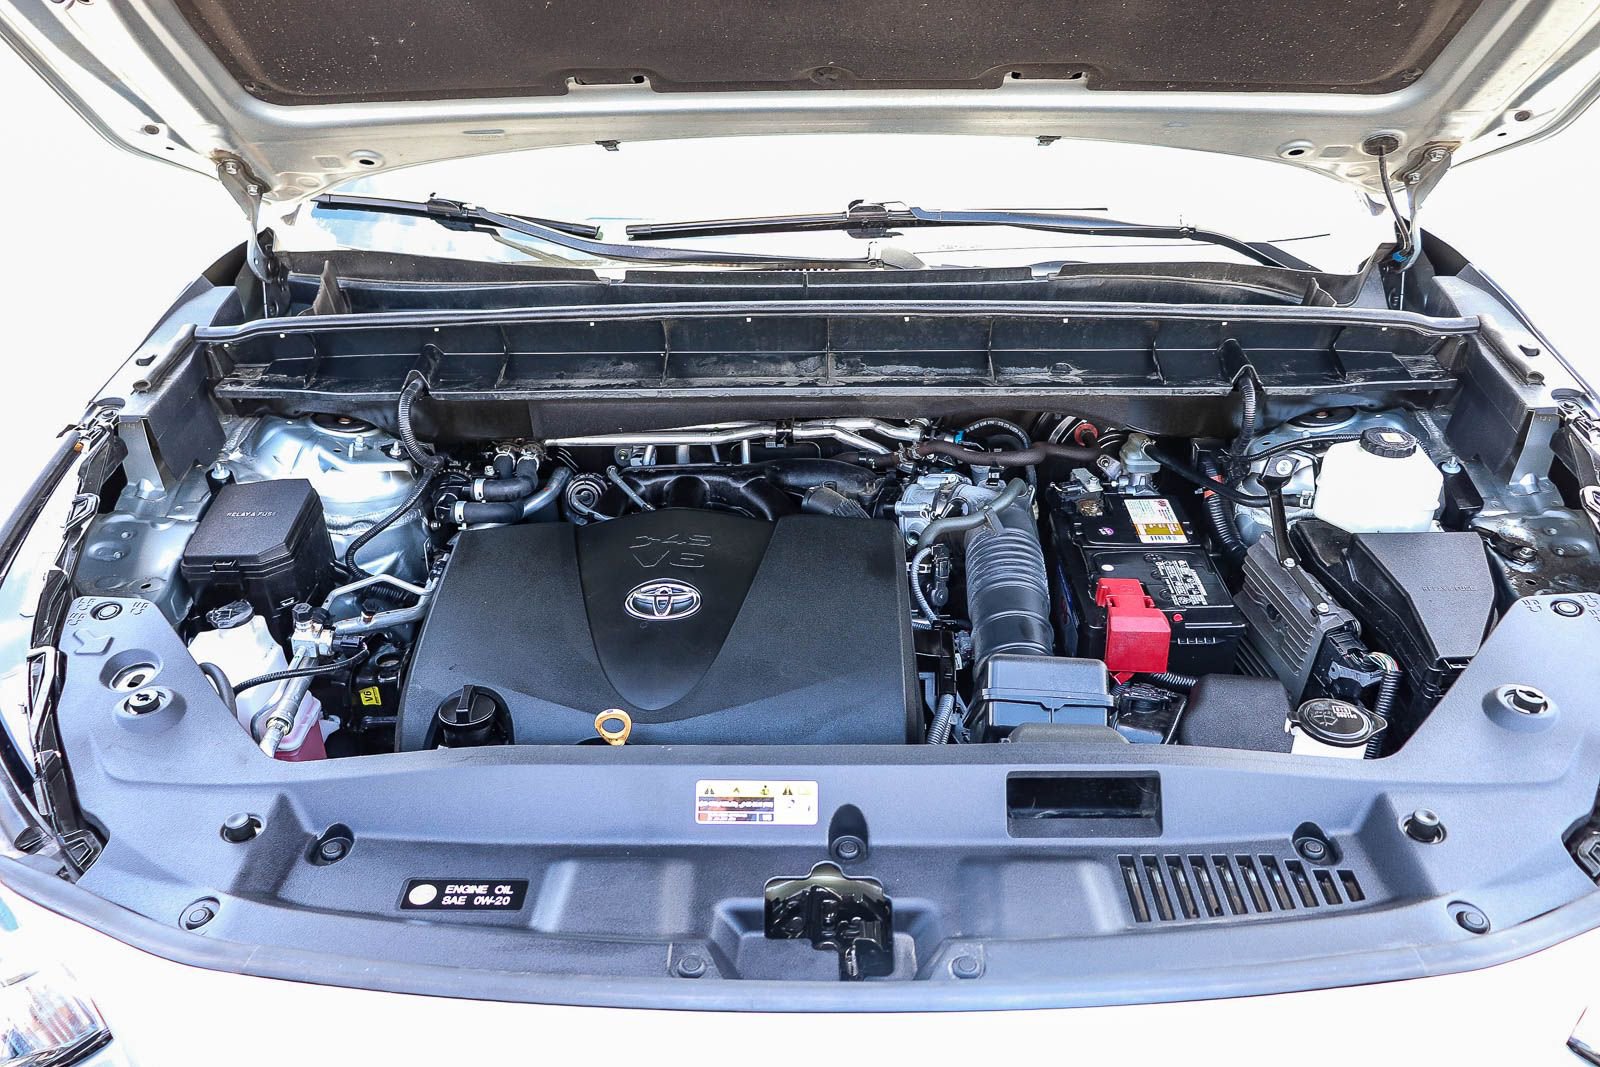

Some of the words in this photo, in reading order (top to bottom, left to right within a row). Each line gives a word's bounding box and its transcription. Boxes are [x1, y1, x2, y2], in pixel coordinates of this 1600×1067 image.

[363, 690, 374, 702] V6
[444, 884, 489, 895] ENGINE
[494, 884, 514, 895] OIL
[441, 895, 468, 905] SAE
[473, 895, 511, 905] 0W-20
